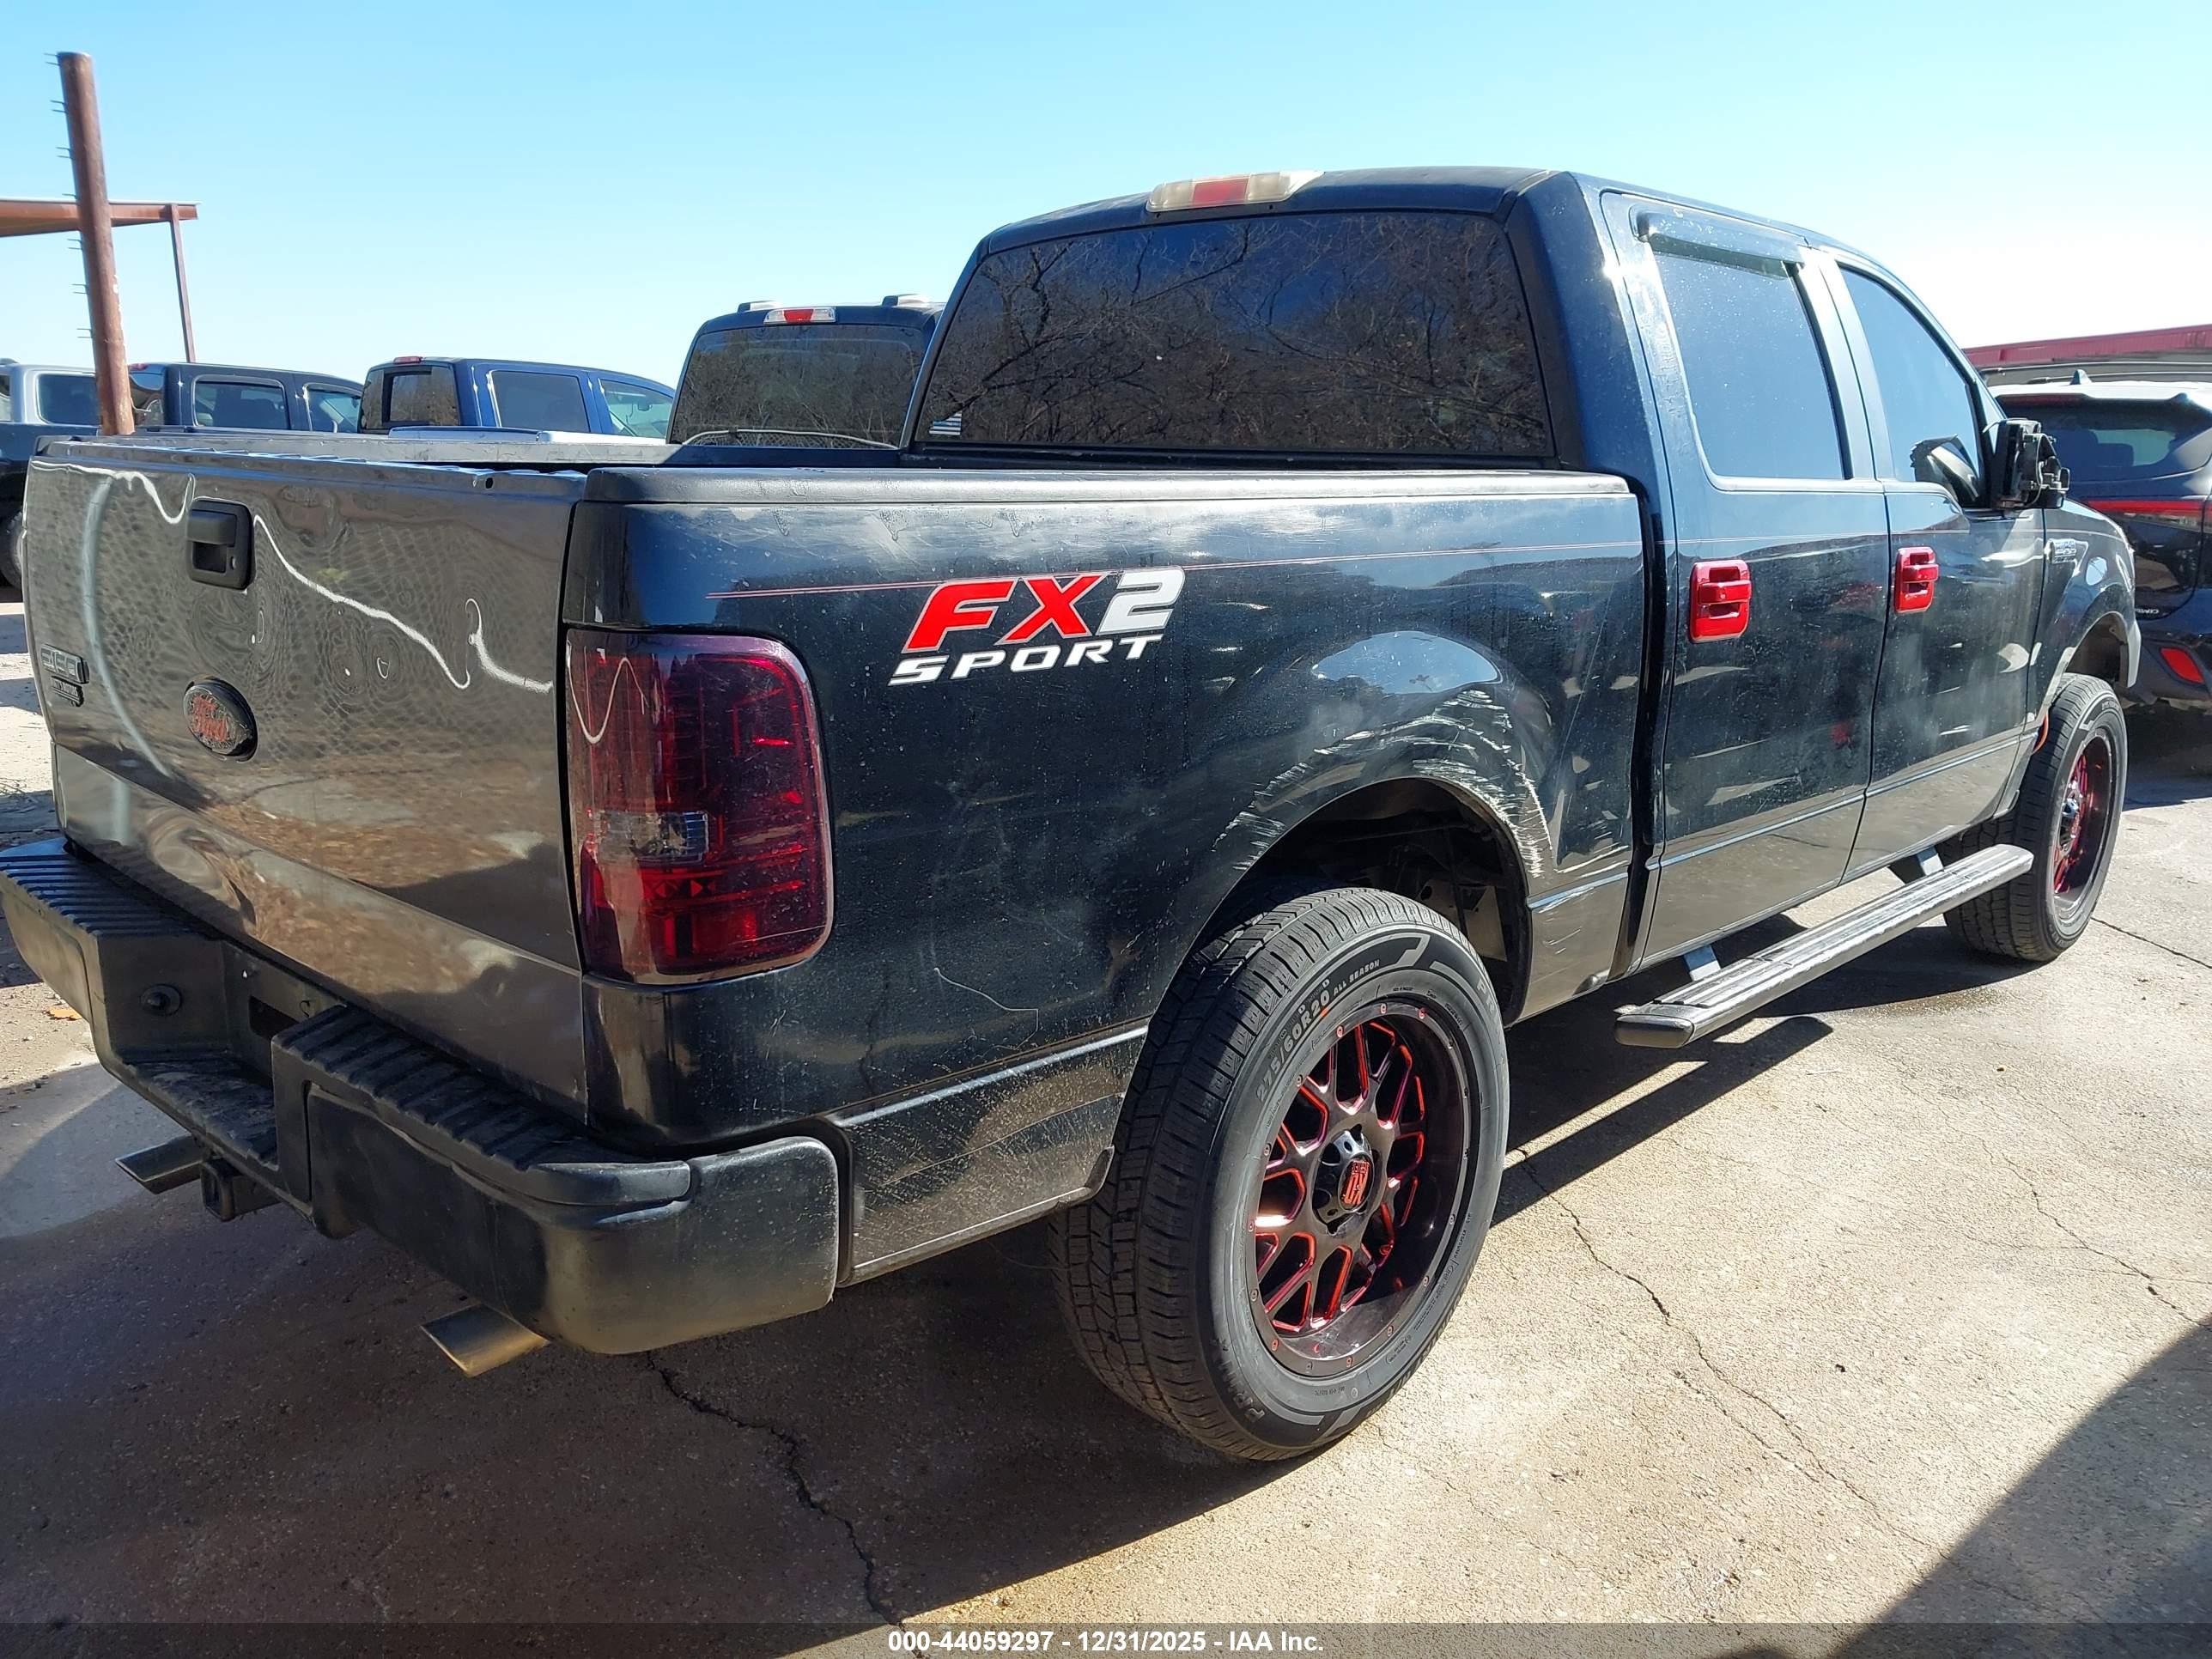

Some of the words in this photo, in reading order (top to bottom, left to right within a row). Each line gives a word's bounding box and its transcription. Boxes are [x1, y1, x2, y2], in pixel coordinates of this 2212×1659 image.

[901, 565, 1187, 654] FX2
[887, 633, 1164, 687] SPORT
[1255, 989, 1331, 1102] 275/60R20
